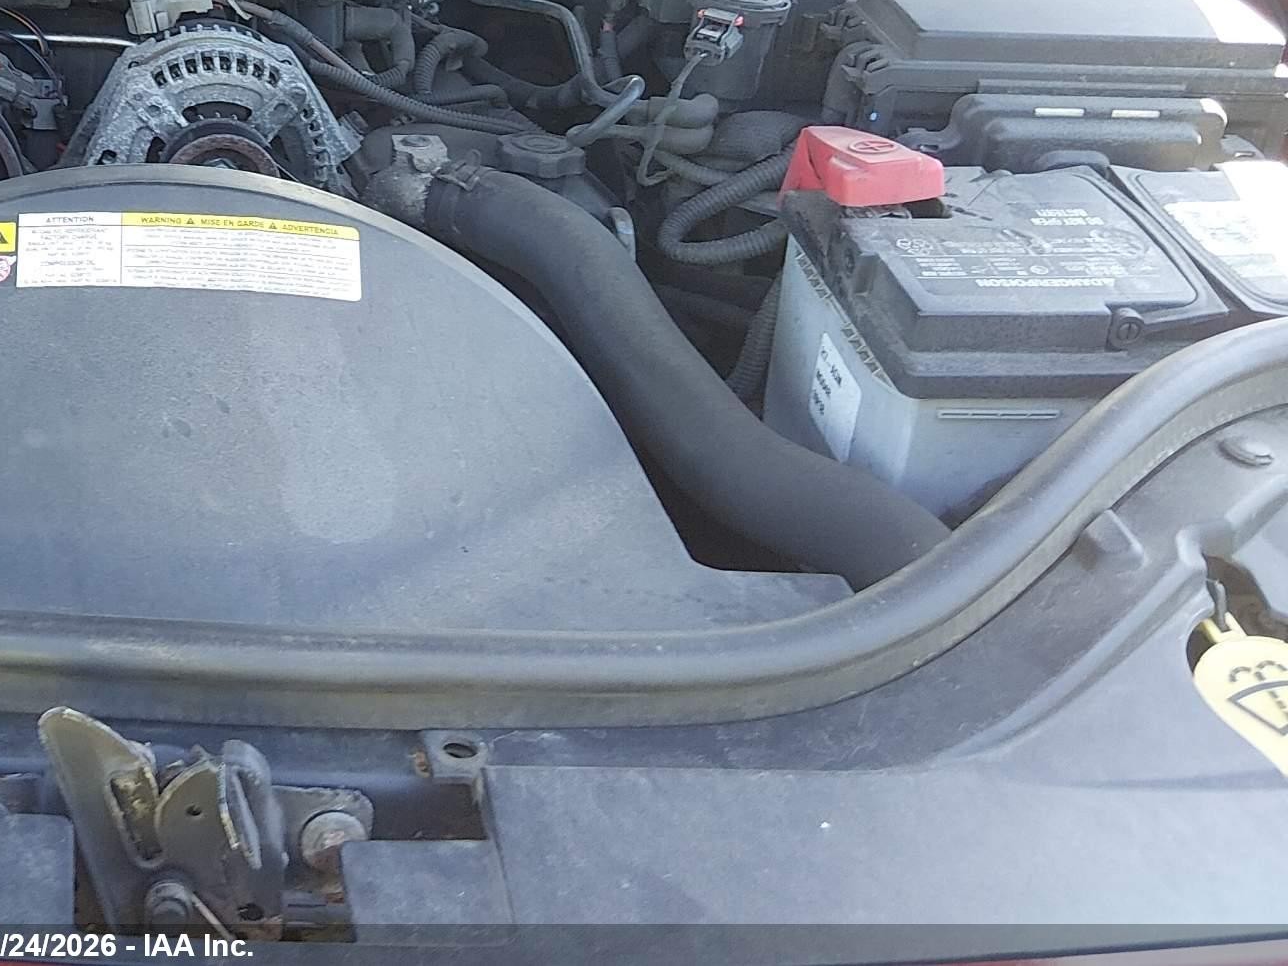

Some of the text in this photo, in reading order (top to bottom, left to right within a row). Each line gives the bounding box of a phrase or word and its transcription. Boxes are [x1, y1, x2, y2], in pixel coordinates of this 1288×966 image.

[45, 215, 95, 224] ATTENTION
[140, 217, 339, 236] WARNING MISE EN GARDE ADVERTENCIA
